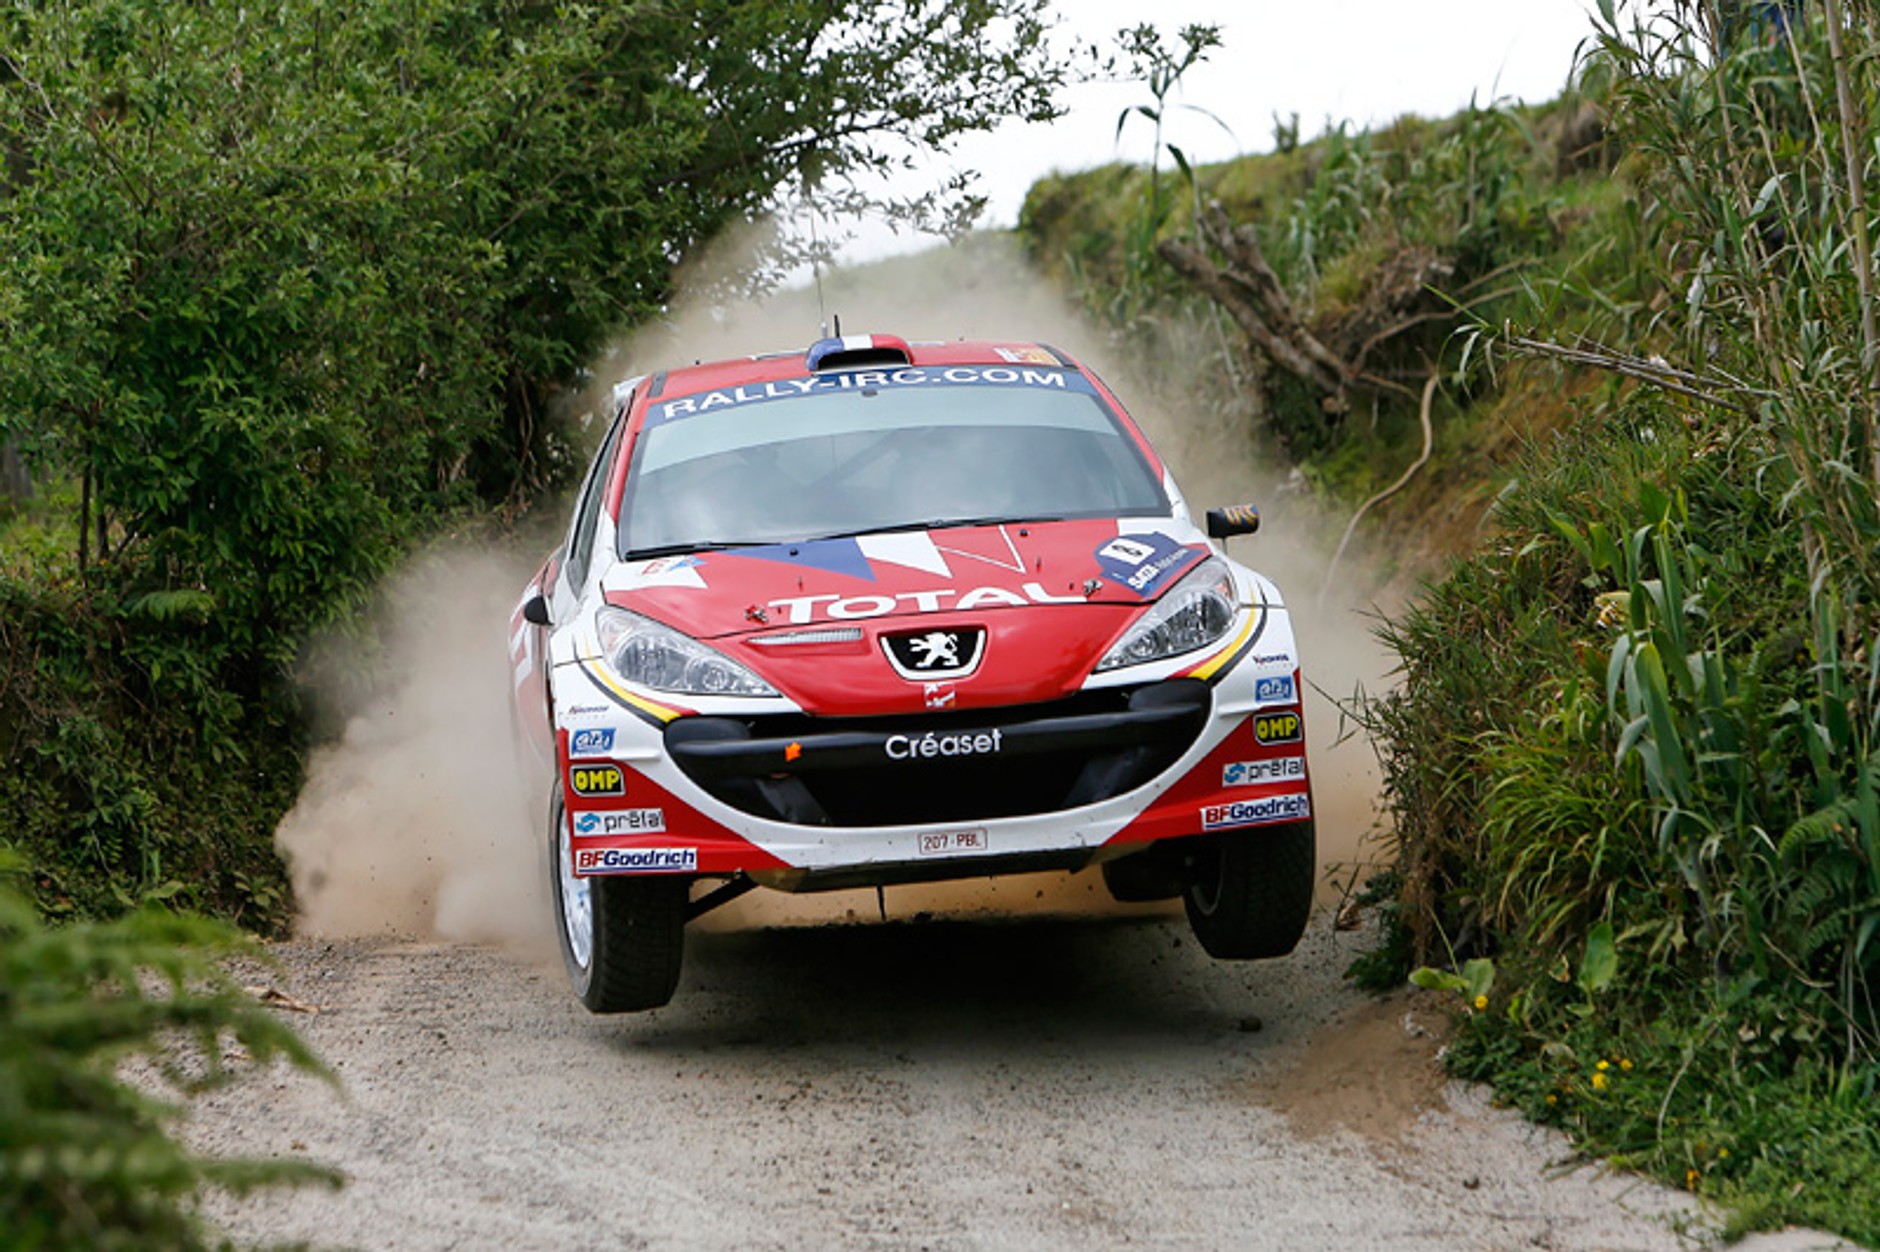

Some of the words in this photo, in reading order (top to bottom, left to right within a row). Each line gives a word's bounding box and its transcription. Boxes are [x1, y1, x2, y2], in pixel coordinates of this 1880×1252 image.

[662, 367, 1066, 420] RALLY-IRC.COM
[768, 582, 1087, 624] TOTAL
[1257, 716, 1298, 739] OMP
[885, 728, 1002, 760] Créaset
[575, 769, 620, 791] OMP
[1205, 795, 1309, 824] BFGoodrich
[579, 849, 695, 868] BFGoodrich
